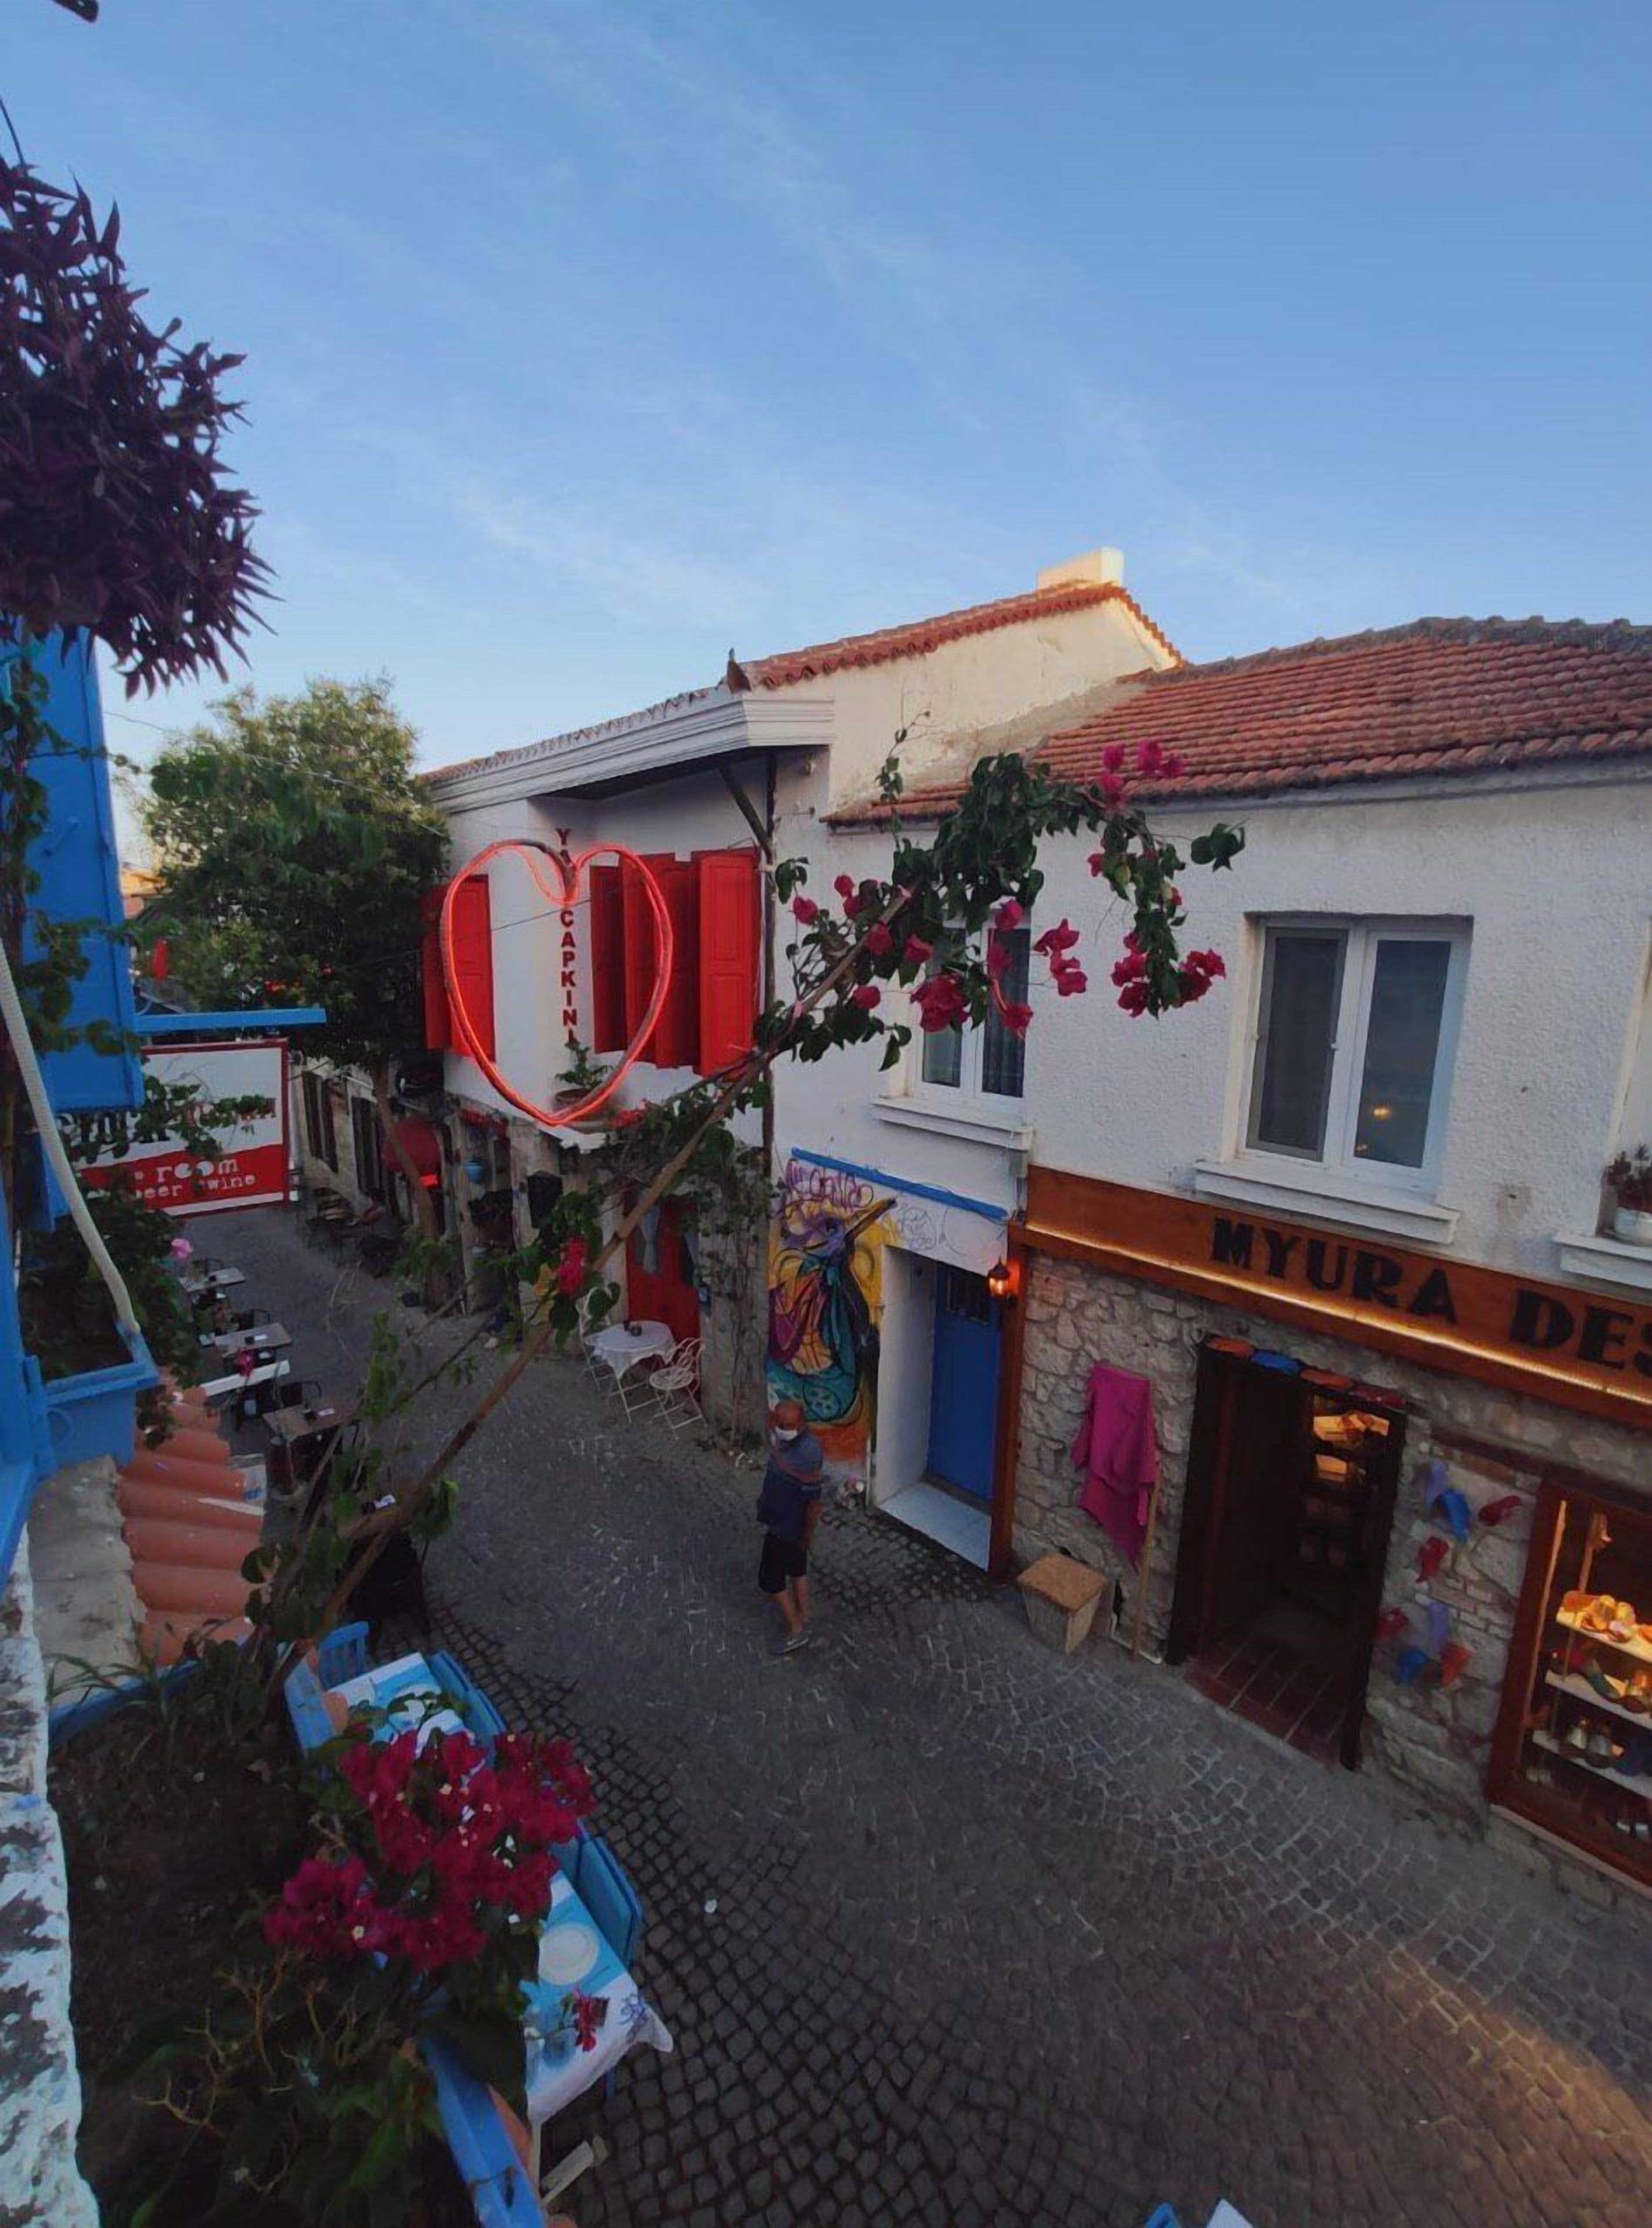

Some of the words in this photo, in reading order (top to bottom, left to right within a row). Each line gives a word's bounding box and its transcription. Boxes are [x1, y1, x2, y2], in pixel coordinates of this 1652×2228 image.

[155, 1158, 238, 1183] room
[207, 1174, 256, 1190] wine
[1210, 1217, 1458, 1325] MYURA
